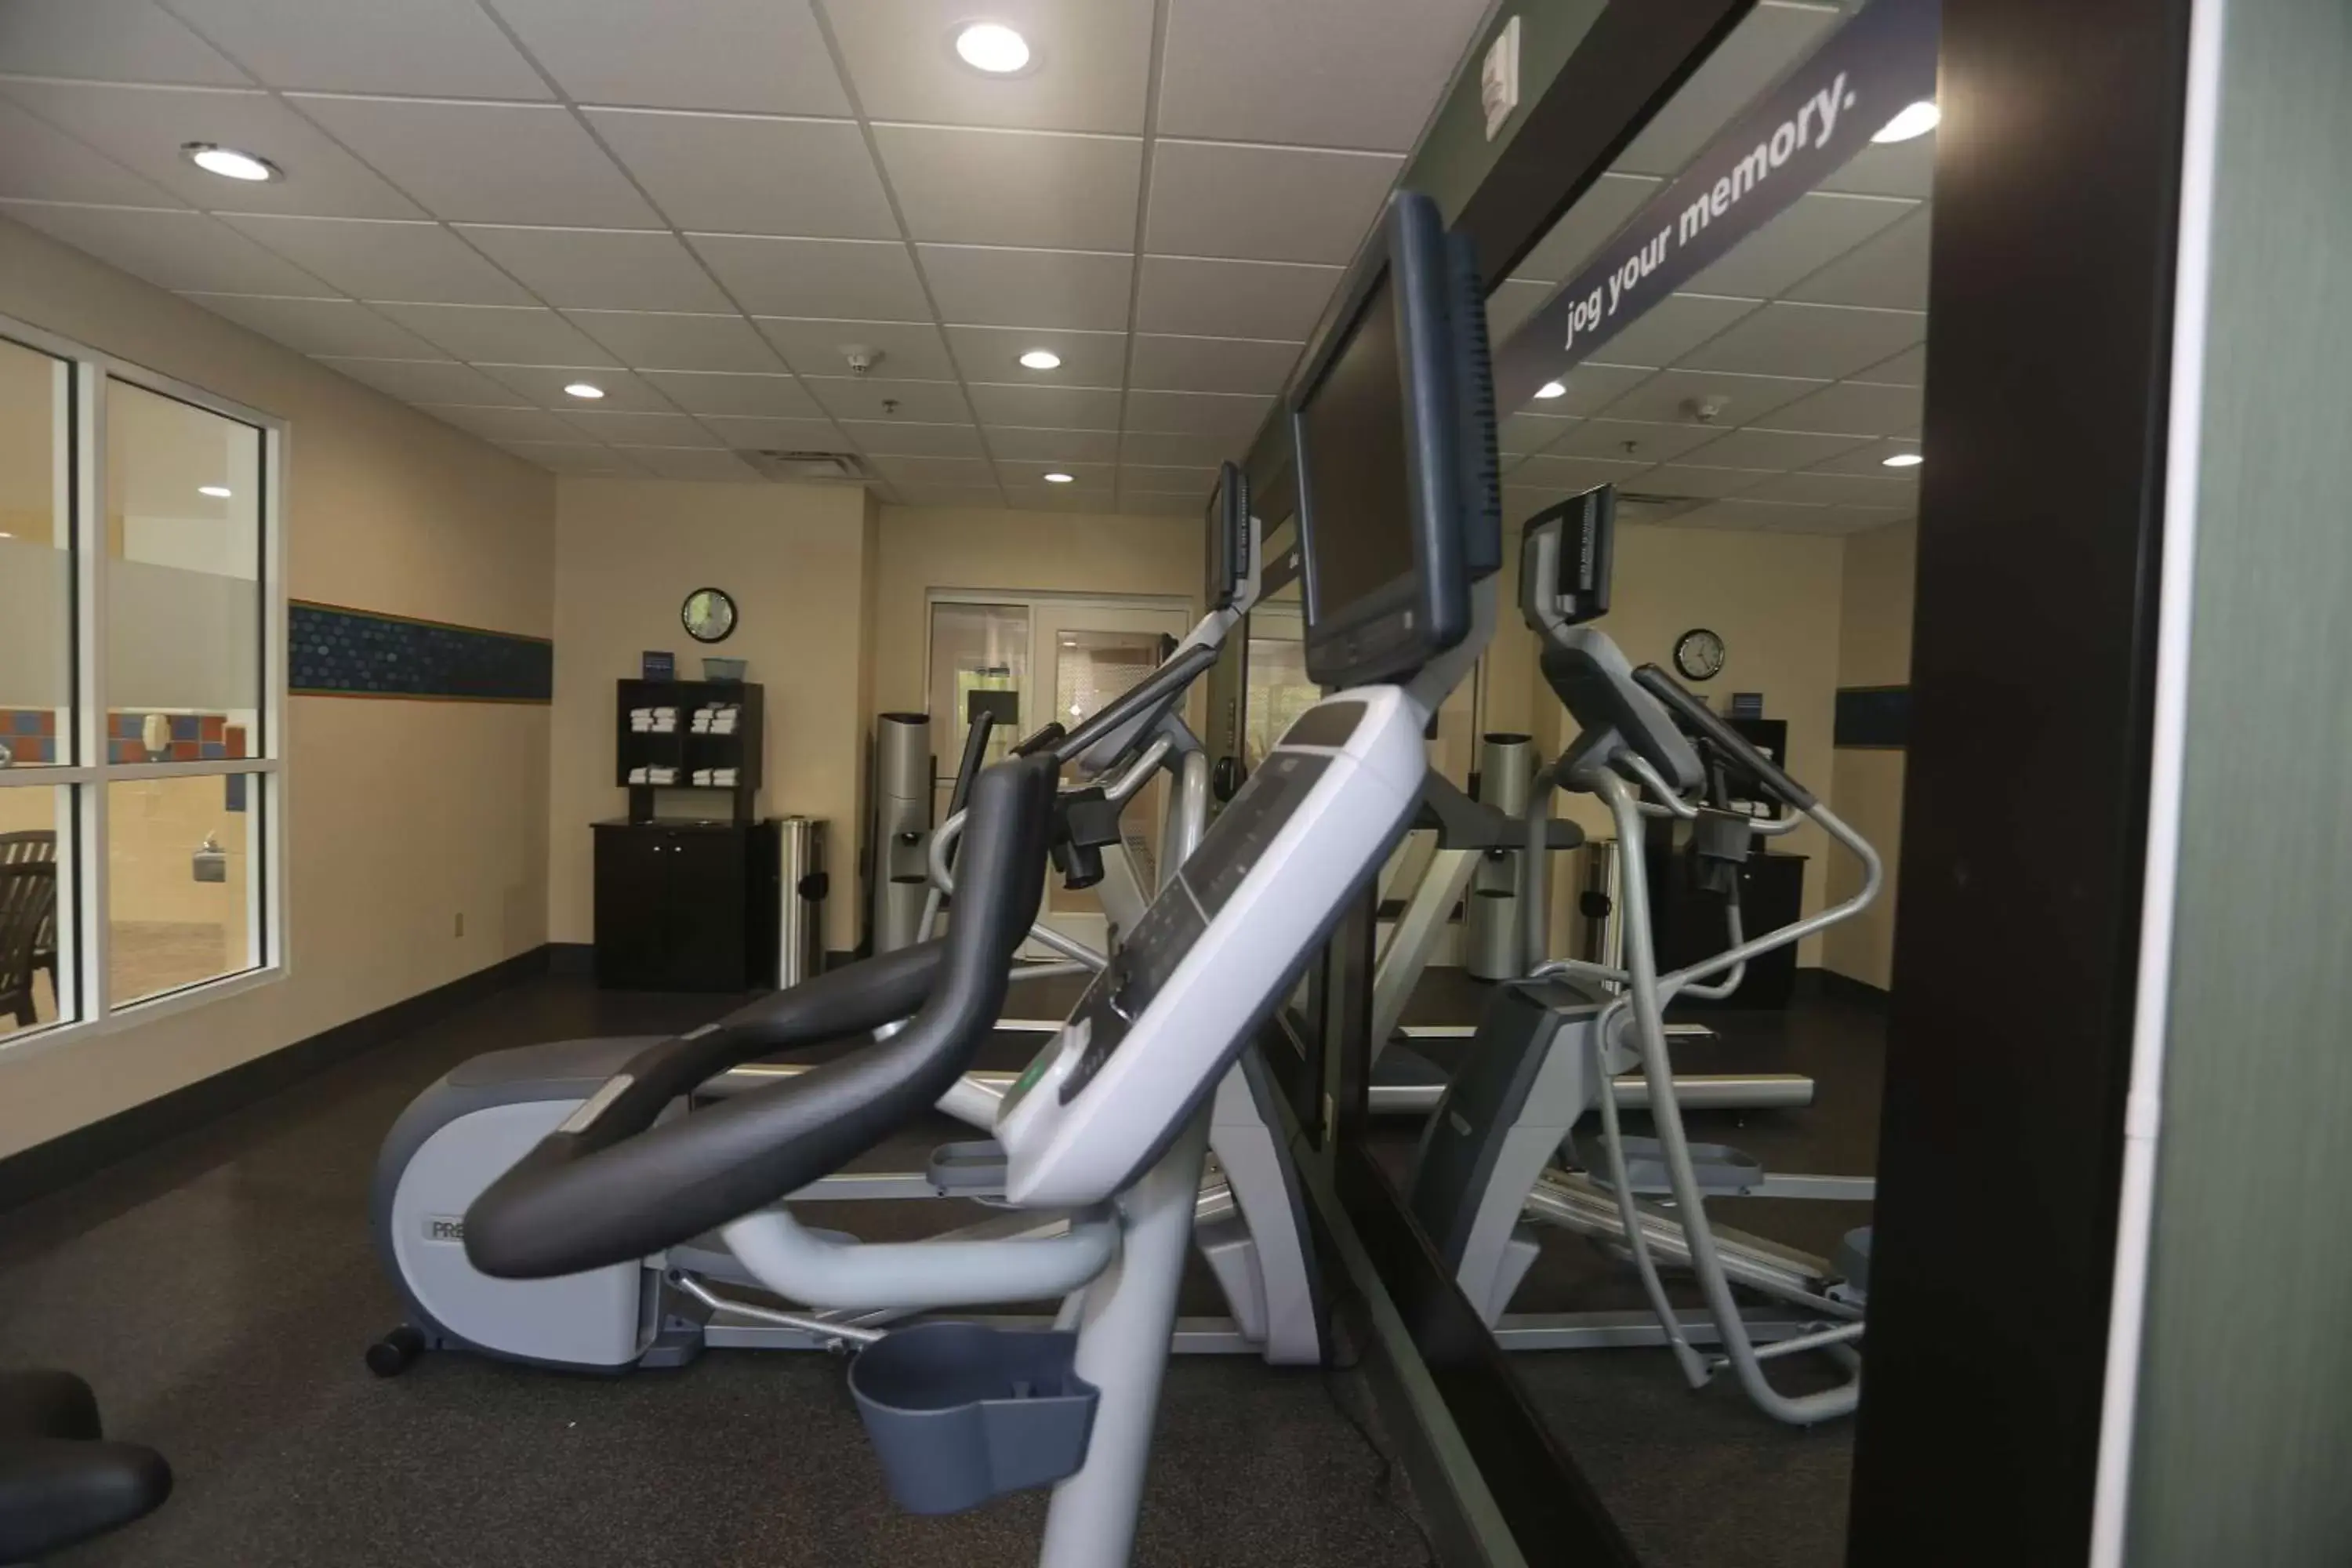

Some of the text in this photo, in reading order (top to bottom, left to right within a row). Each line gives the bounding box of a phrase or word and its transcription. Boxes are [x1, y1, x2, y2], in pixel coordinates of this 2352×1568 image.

[1565, 71, 1857, 350] jog your memory.
